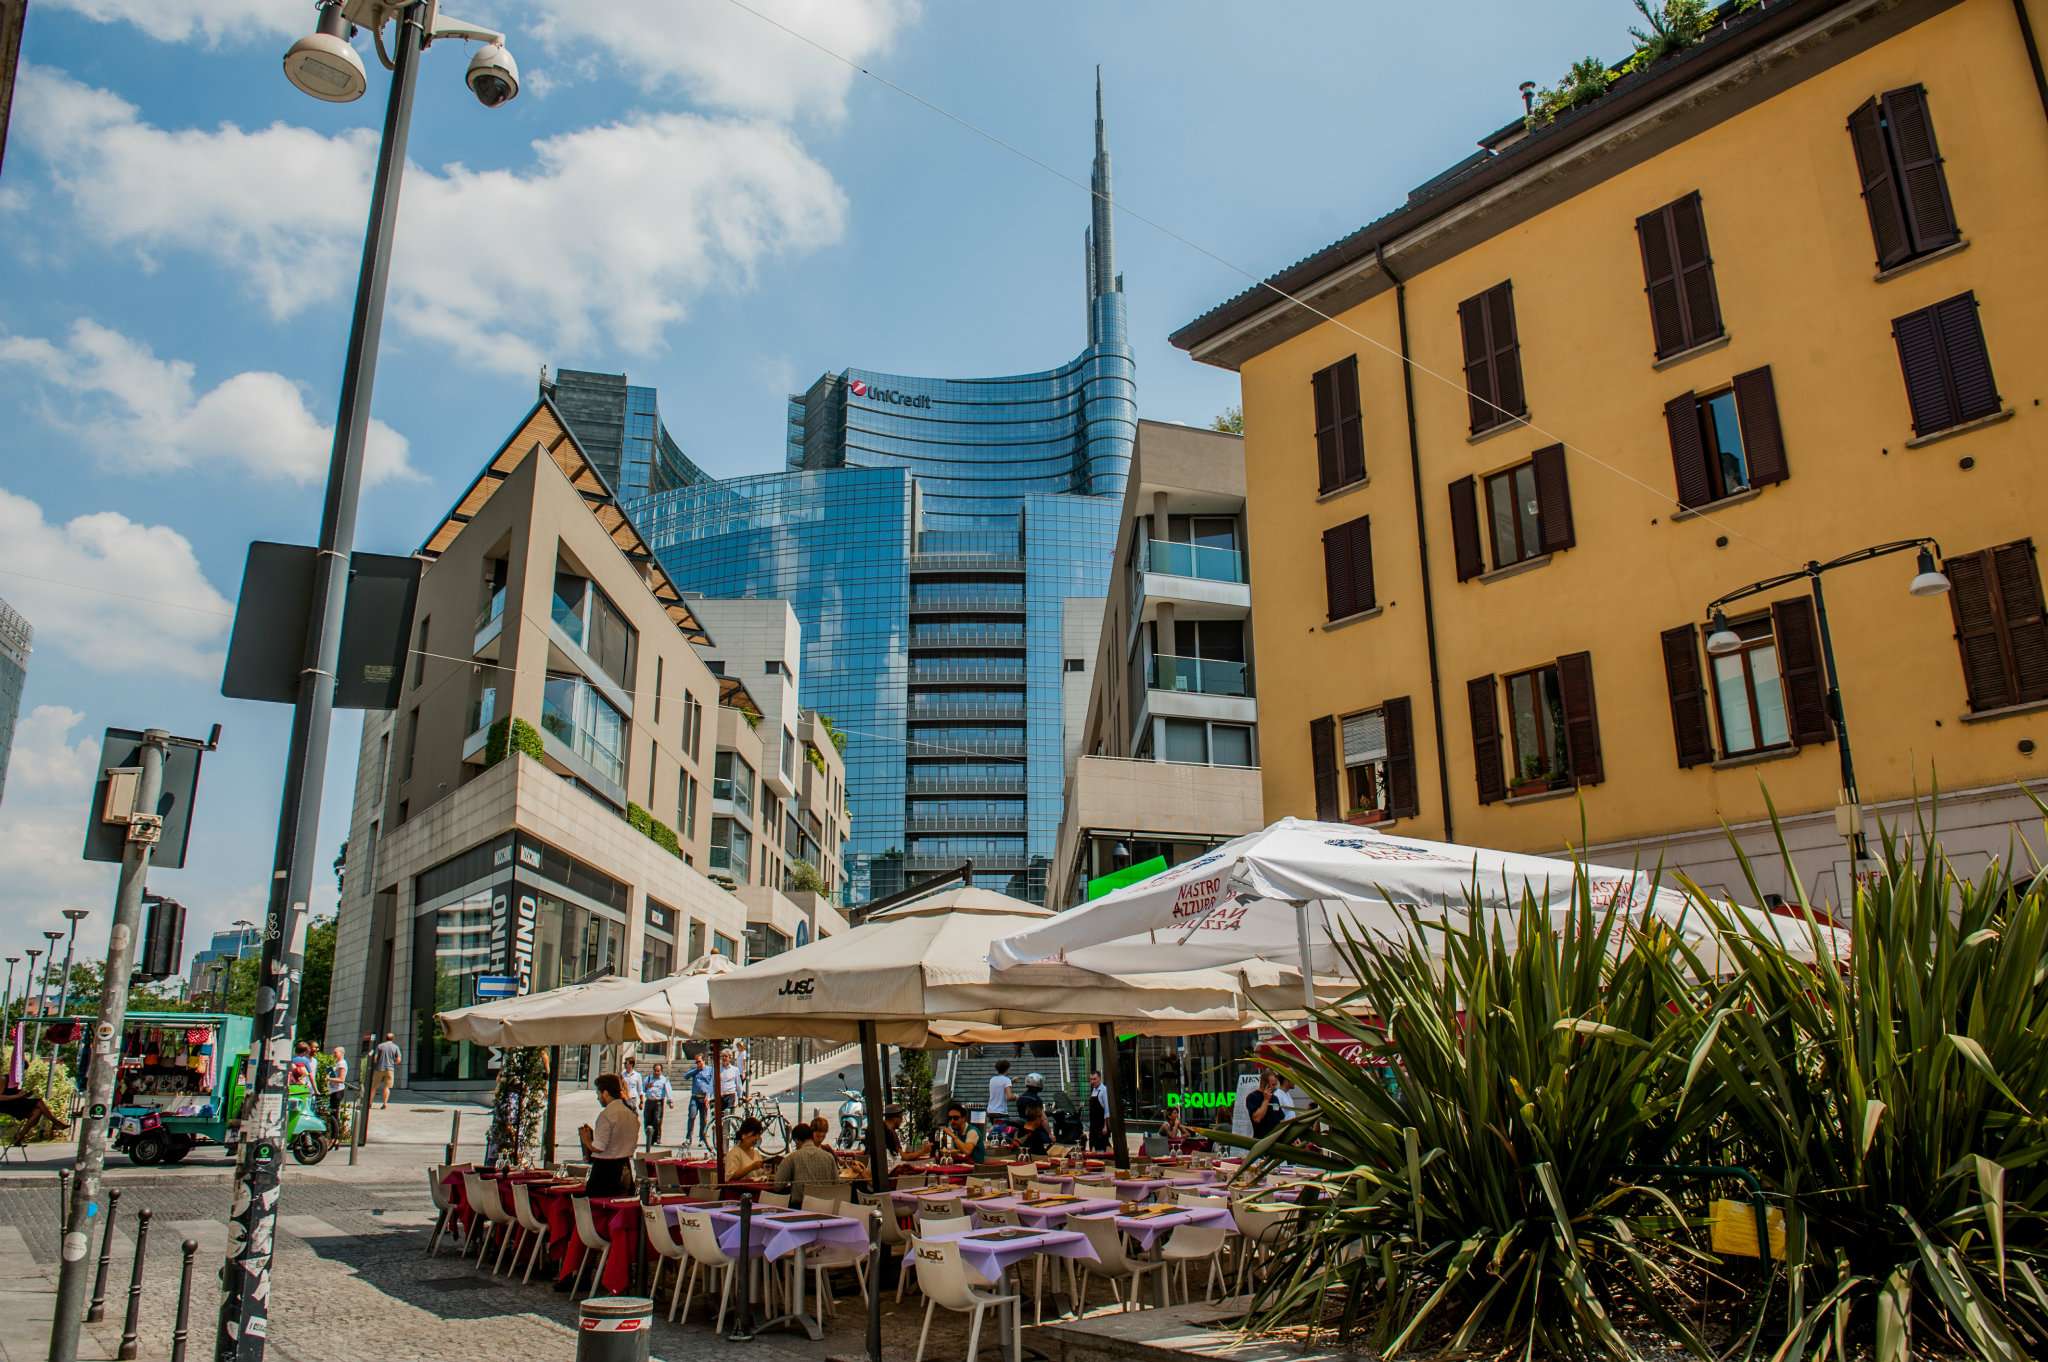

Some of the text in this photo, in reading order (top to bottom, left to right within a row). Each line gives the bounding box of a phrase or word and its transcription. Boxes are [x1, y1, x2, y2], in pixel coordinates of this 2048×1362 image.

[868, 386, 931, 409] UniCredit
[1178, 878, 1221, 901] NASTRO
[1172, 896, 1217, 918] AZZURR
[1240, 1076, 1261, 1087] MEN
